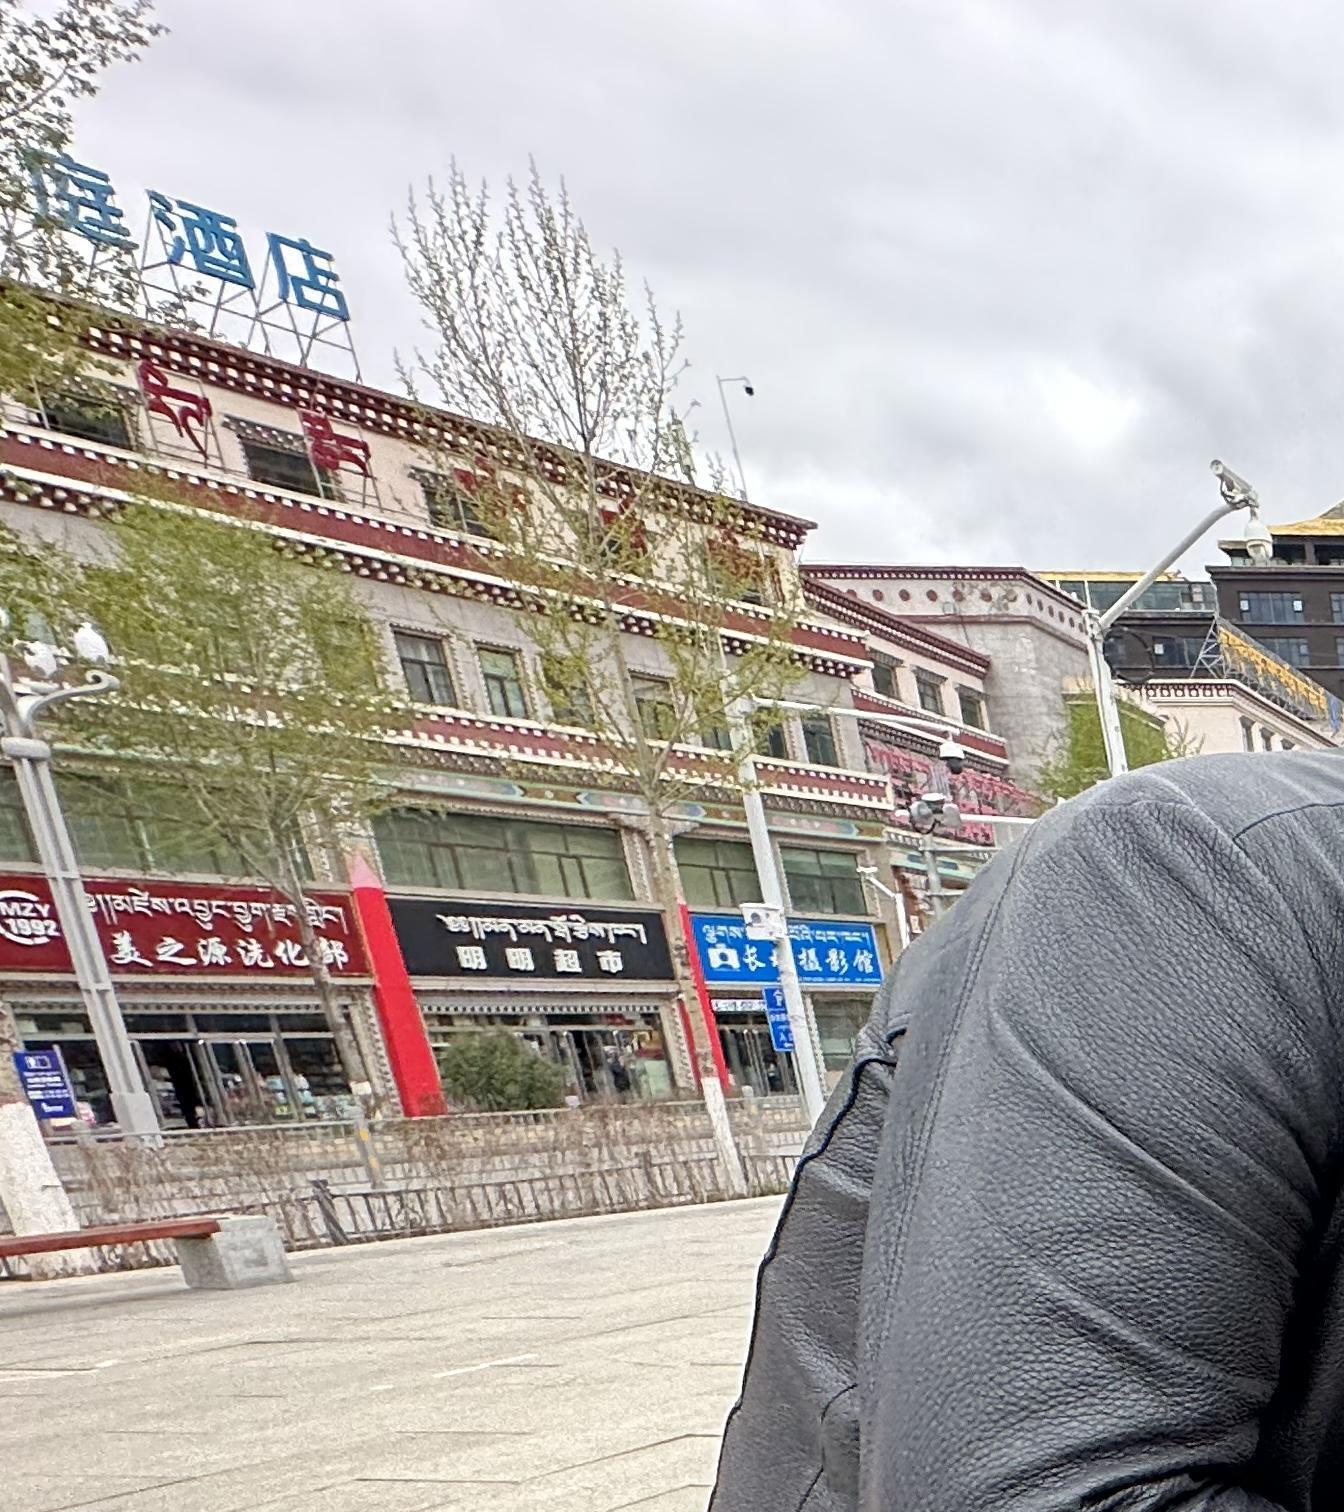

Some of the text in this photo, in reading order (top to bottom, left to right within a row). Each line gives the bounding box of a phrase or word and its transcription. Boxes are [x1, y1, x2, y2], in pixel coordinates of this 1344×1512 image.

[0, 902, 50, 918] MZY
[4, 918, 61, 937] 1992
[110, 931, 349, 970] 美之源洗化部
[456, 946, 624, 973] 明明超市
